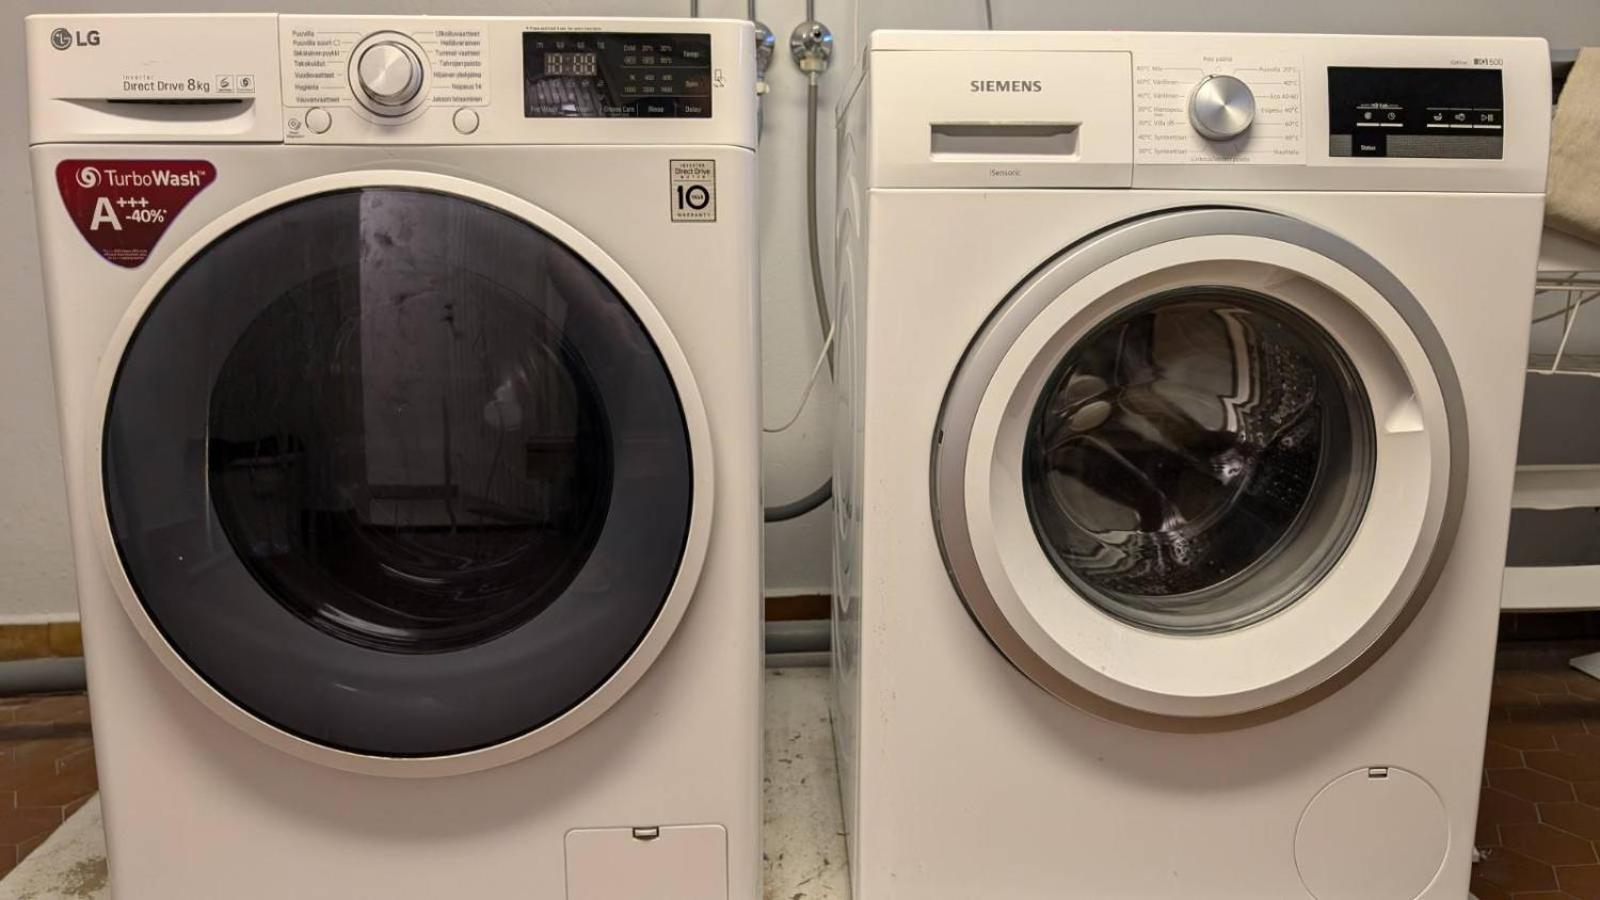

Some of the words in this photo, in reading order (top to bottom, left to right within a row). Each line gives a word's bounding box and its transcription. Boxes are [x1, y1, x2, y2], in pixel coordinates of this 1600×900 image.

[76, 30, 101, 47] LG
[123, 80, 155, 92] Direct
[157, 80, 185, 92] Drive
[970, 80, 1042, 93] SIEMENS
[677, 185, 710, 210] 10
